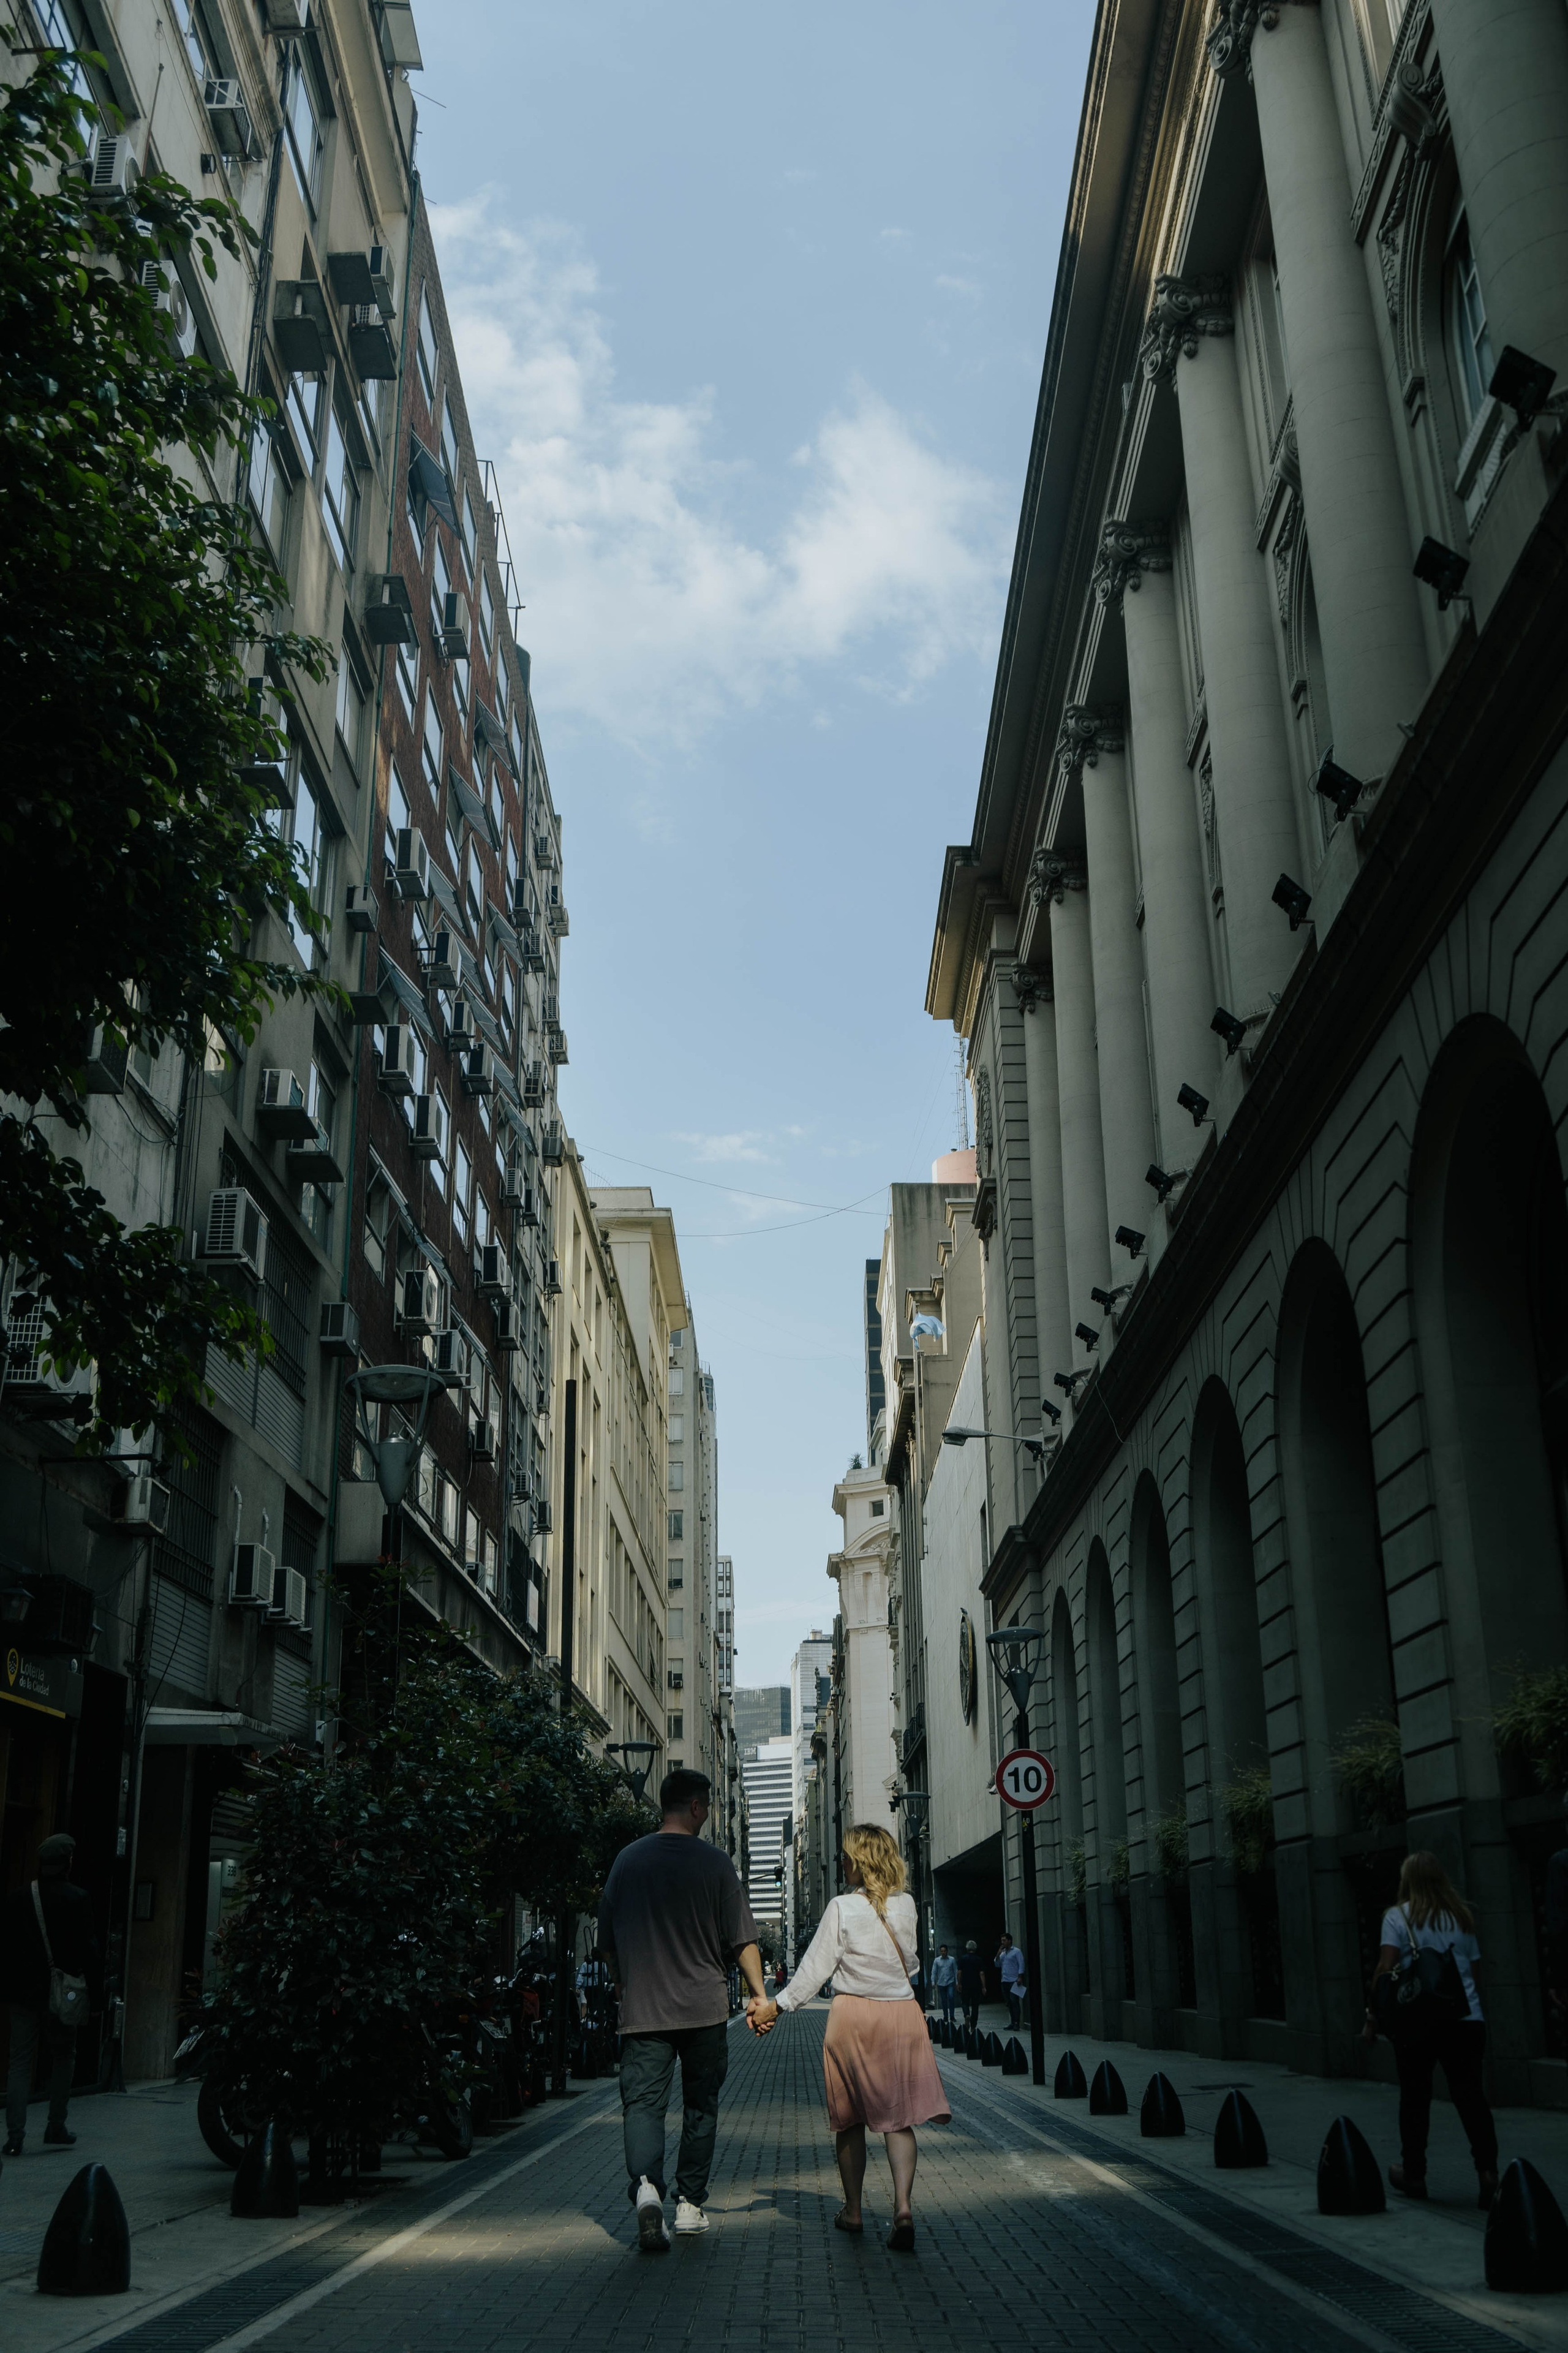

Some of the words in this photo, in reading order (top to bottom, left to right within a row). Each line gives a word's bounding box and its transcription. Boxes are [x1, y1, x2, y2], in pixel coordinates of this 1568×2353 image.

[19, 1675, 26, 1688] de
[26, 1677, 32, 1690] la
[32, 1680, 49, 1696] Ciudad
[1008, 1766, 1042, 1792] 10
